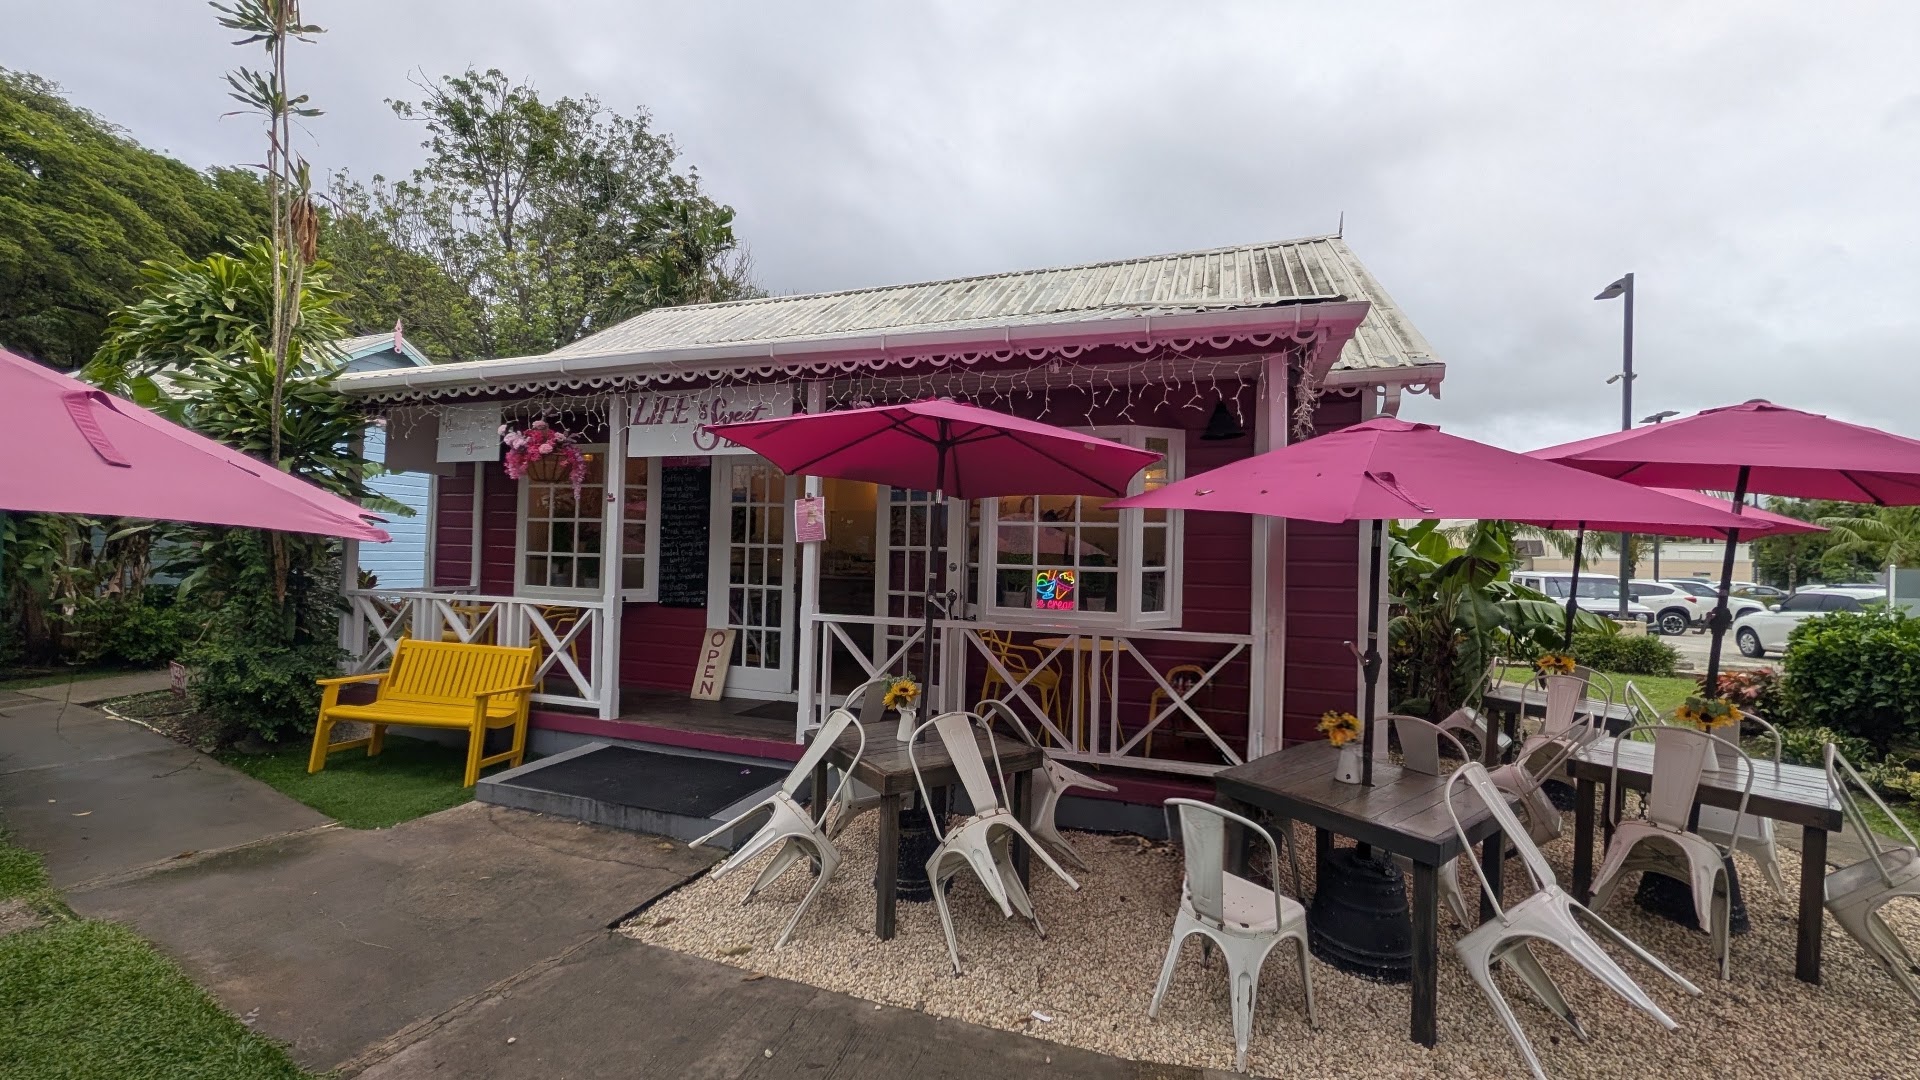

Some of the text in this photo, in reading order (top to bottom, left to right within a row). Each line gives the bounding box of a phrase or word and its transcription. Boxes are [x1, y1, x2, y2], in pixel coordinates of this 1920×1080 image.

[631, 395, 695, 426] LIFE
[699, 400, 708, 420] is
[700, 631, 726, 696] OPEN
